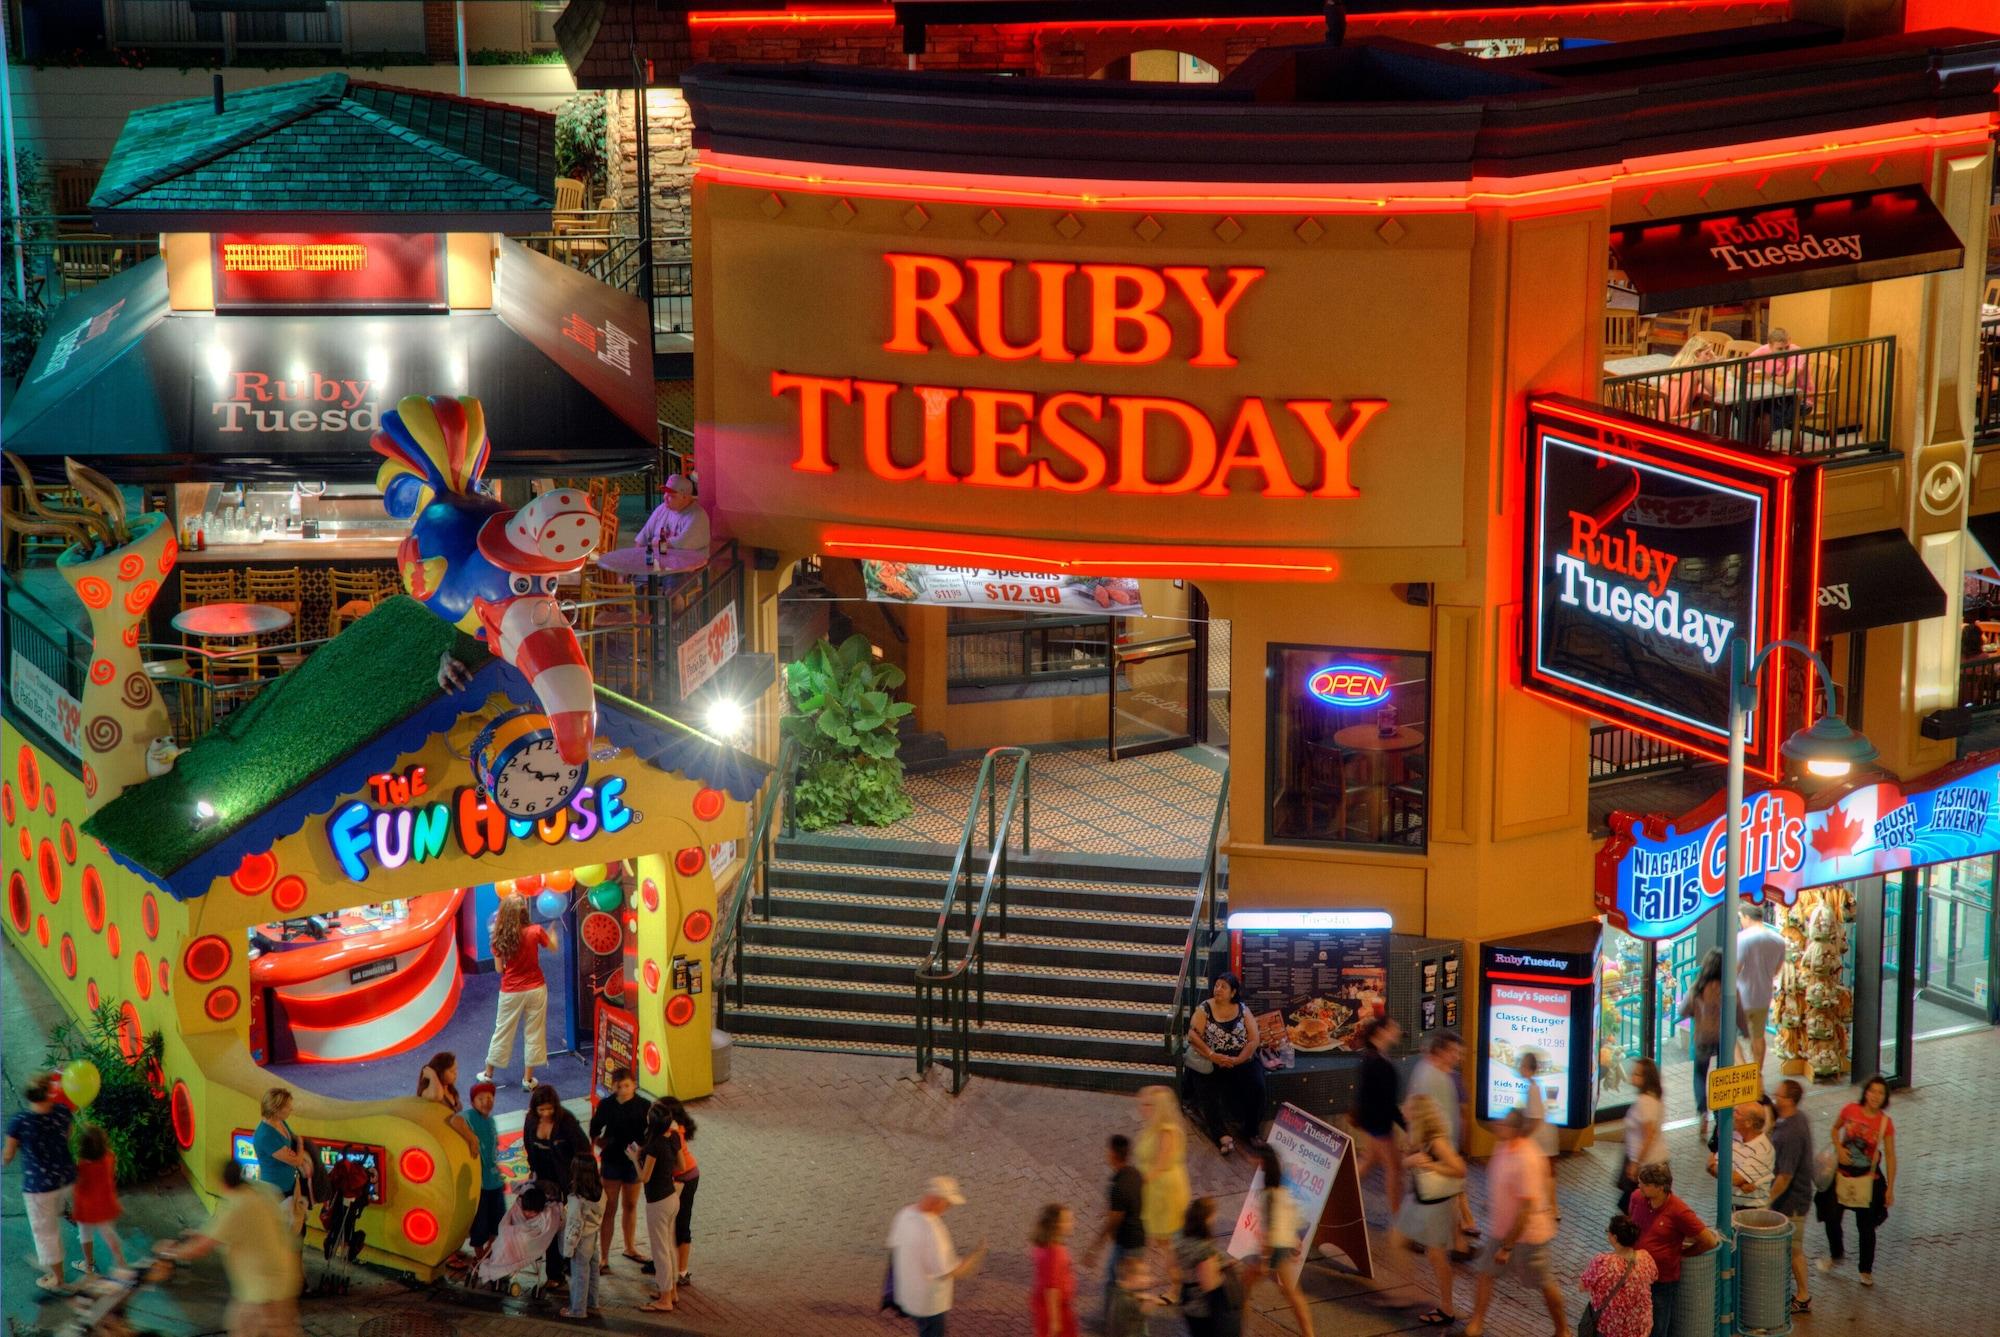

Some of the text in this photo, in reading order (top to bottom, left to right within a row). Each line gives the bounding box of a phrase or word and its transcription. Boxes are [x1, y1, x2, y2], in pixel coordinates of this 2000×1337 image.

[1711, 215, 1800, 246] Ruby
[1711, 233, 1862, 271] Tuesday
[882, 252, 1266, 367] RUBY
[229, 371, 375, 409] Ruby
[770, 370, 1390, 499] TUESDAY
[1567, 511, 1678, 597] Ruby
[985, 583, 1062, 604] $12.99
[1556, 554, 1734, 665] Tuesday
[1312, 674, 1387, 696] OPEN
[536, 740, 553, 750] 12
[509, 757, 518, 767] 2
[368, 765, 428, 806] THE
[499, 773, 508, 783] 3
[568, 769, 578, 780] 9
[500, 788, 509, 798] 4
[558, 786, 568, 796] 8
[1935, 787, 1991, 812] FASHION
[509, 799, 519, 809] 5
[526, 802, 536, 812] 6
[545, 797, 554, 808] 7
[1874, 803, 1918, 837] PLUSH
[1930, 809, 1987, 836] JEWELRY
[325, 801, 450, 882] FUN
[1700, 794, 1807, 898] Gifts
[1881, 826, 1916, 850] TOYS
[1633, 840, 1699, 877] NIAGARA
[1632, 871, 1701, 922] Falls
[1496, 989, 1567, 1003] Today's Special
[1496, 1012, 1565, 1026] Classic Burger
[1521, 1025, 1548, 1034] Fries!
[1538, 1039, 1565, 1048] $12.99
[1494, 1080, 1513, 1088] Kids
[1712, 1069, 1756, 1088] VEHICLES HAVE
[1713, 1085, 1753, 1102] RIGHT OF WAY
[1275, 1130, 1332, 1170] Daily Specials
